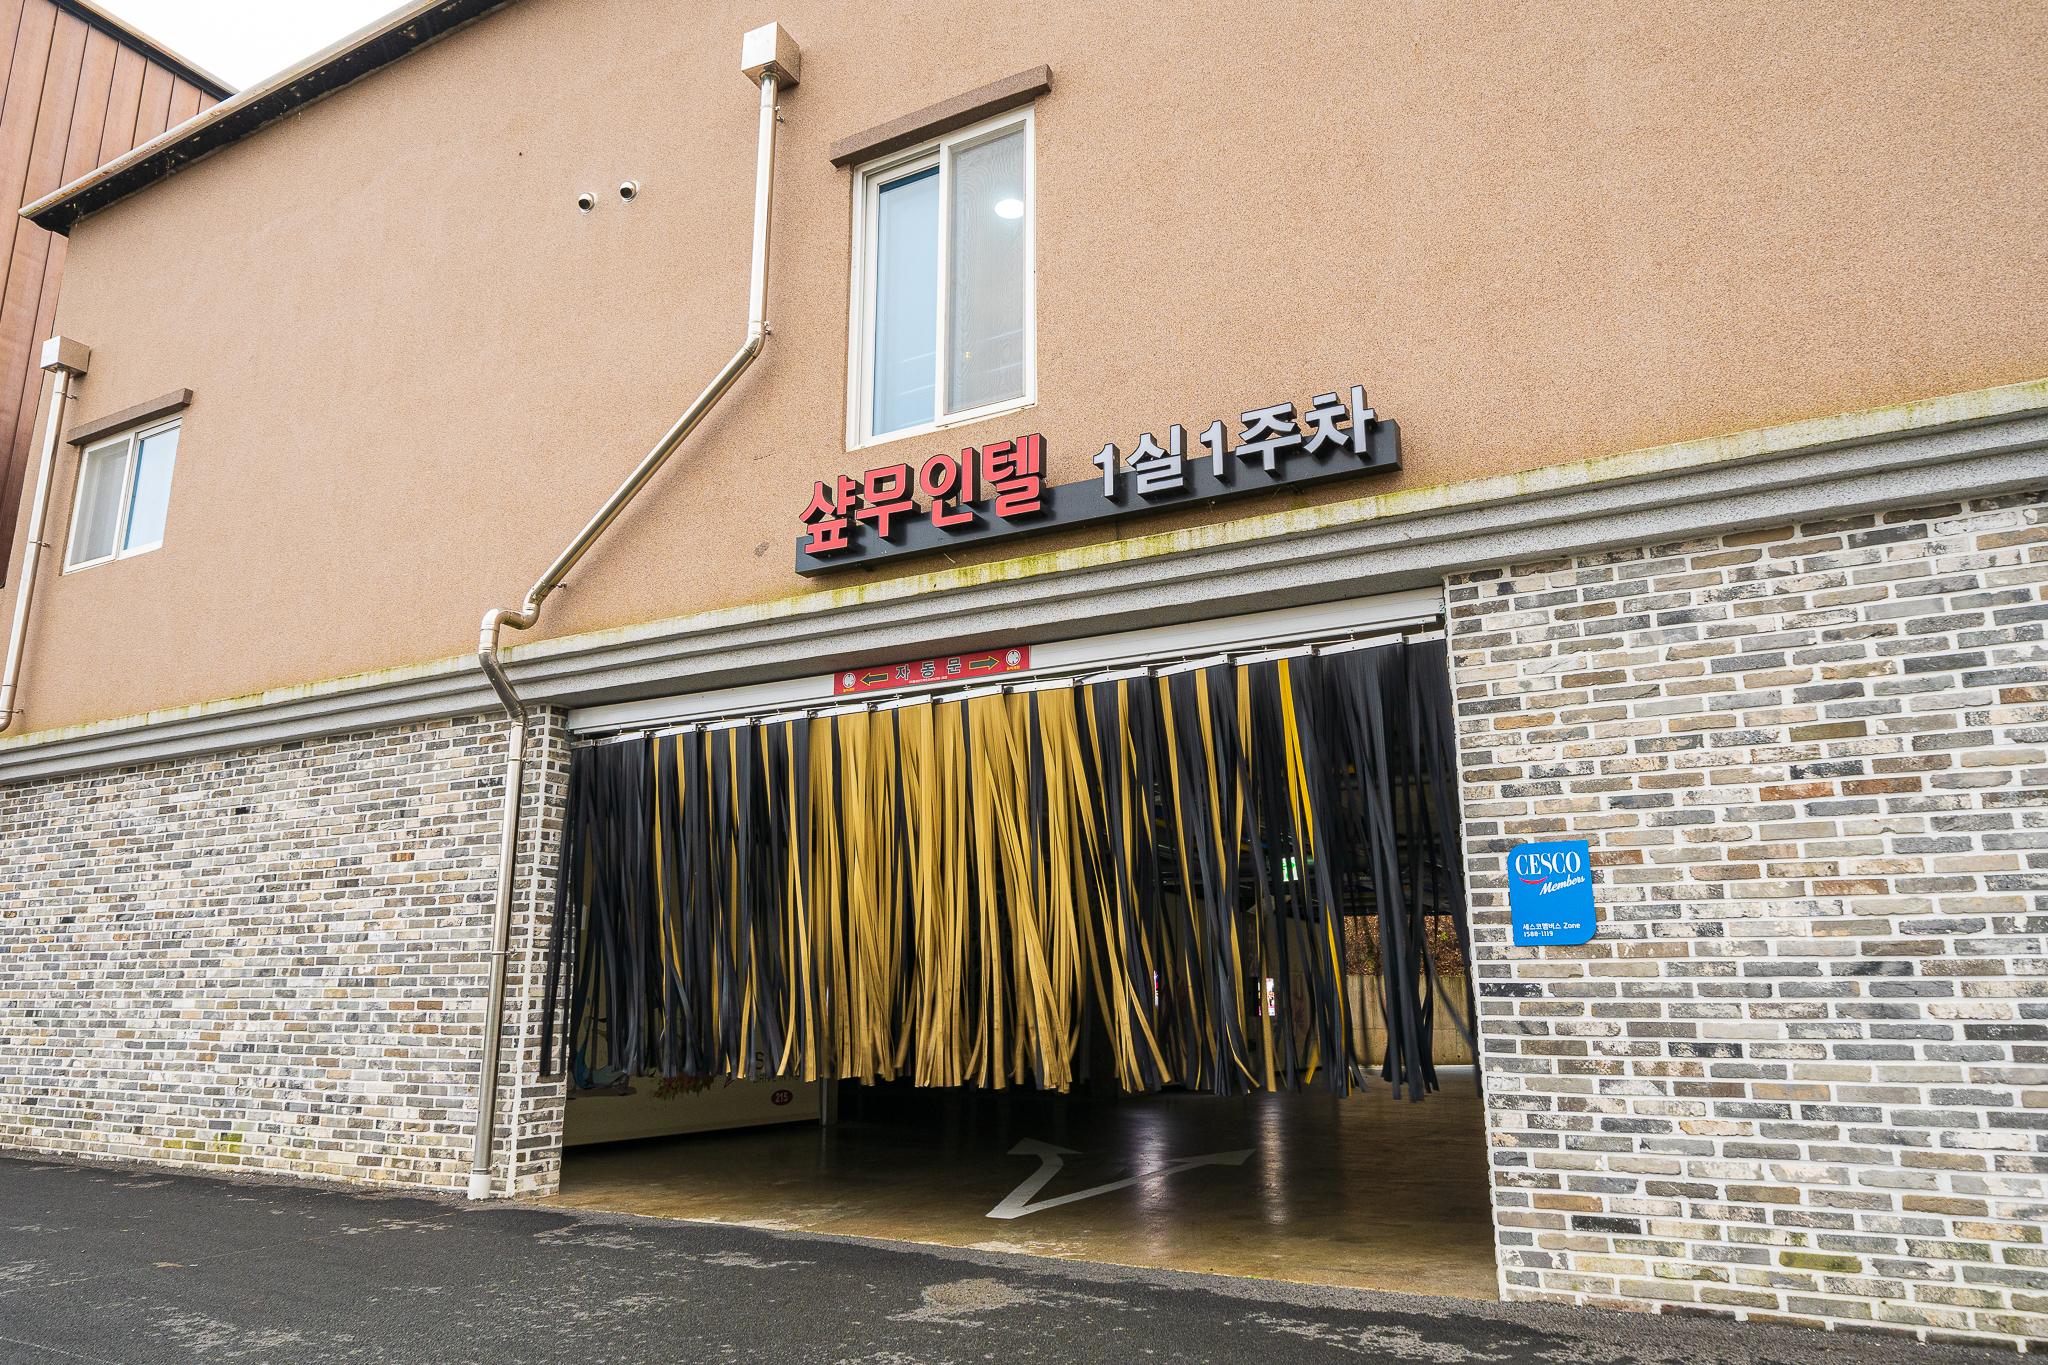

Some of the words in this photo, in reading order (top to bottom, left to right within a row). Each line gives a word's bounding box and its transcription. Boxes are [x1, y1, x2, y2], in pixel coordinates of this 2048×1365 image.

[799, 433, 1042, 554] 샾무인텔
[1515, 851, 1581, 876] CESCO
[1539, 874, 1586, 896] Members
[1563, 922, 1581, 930] Zone
